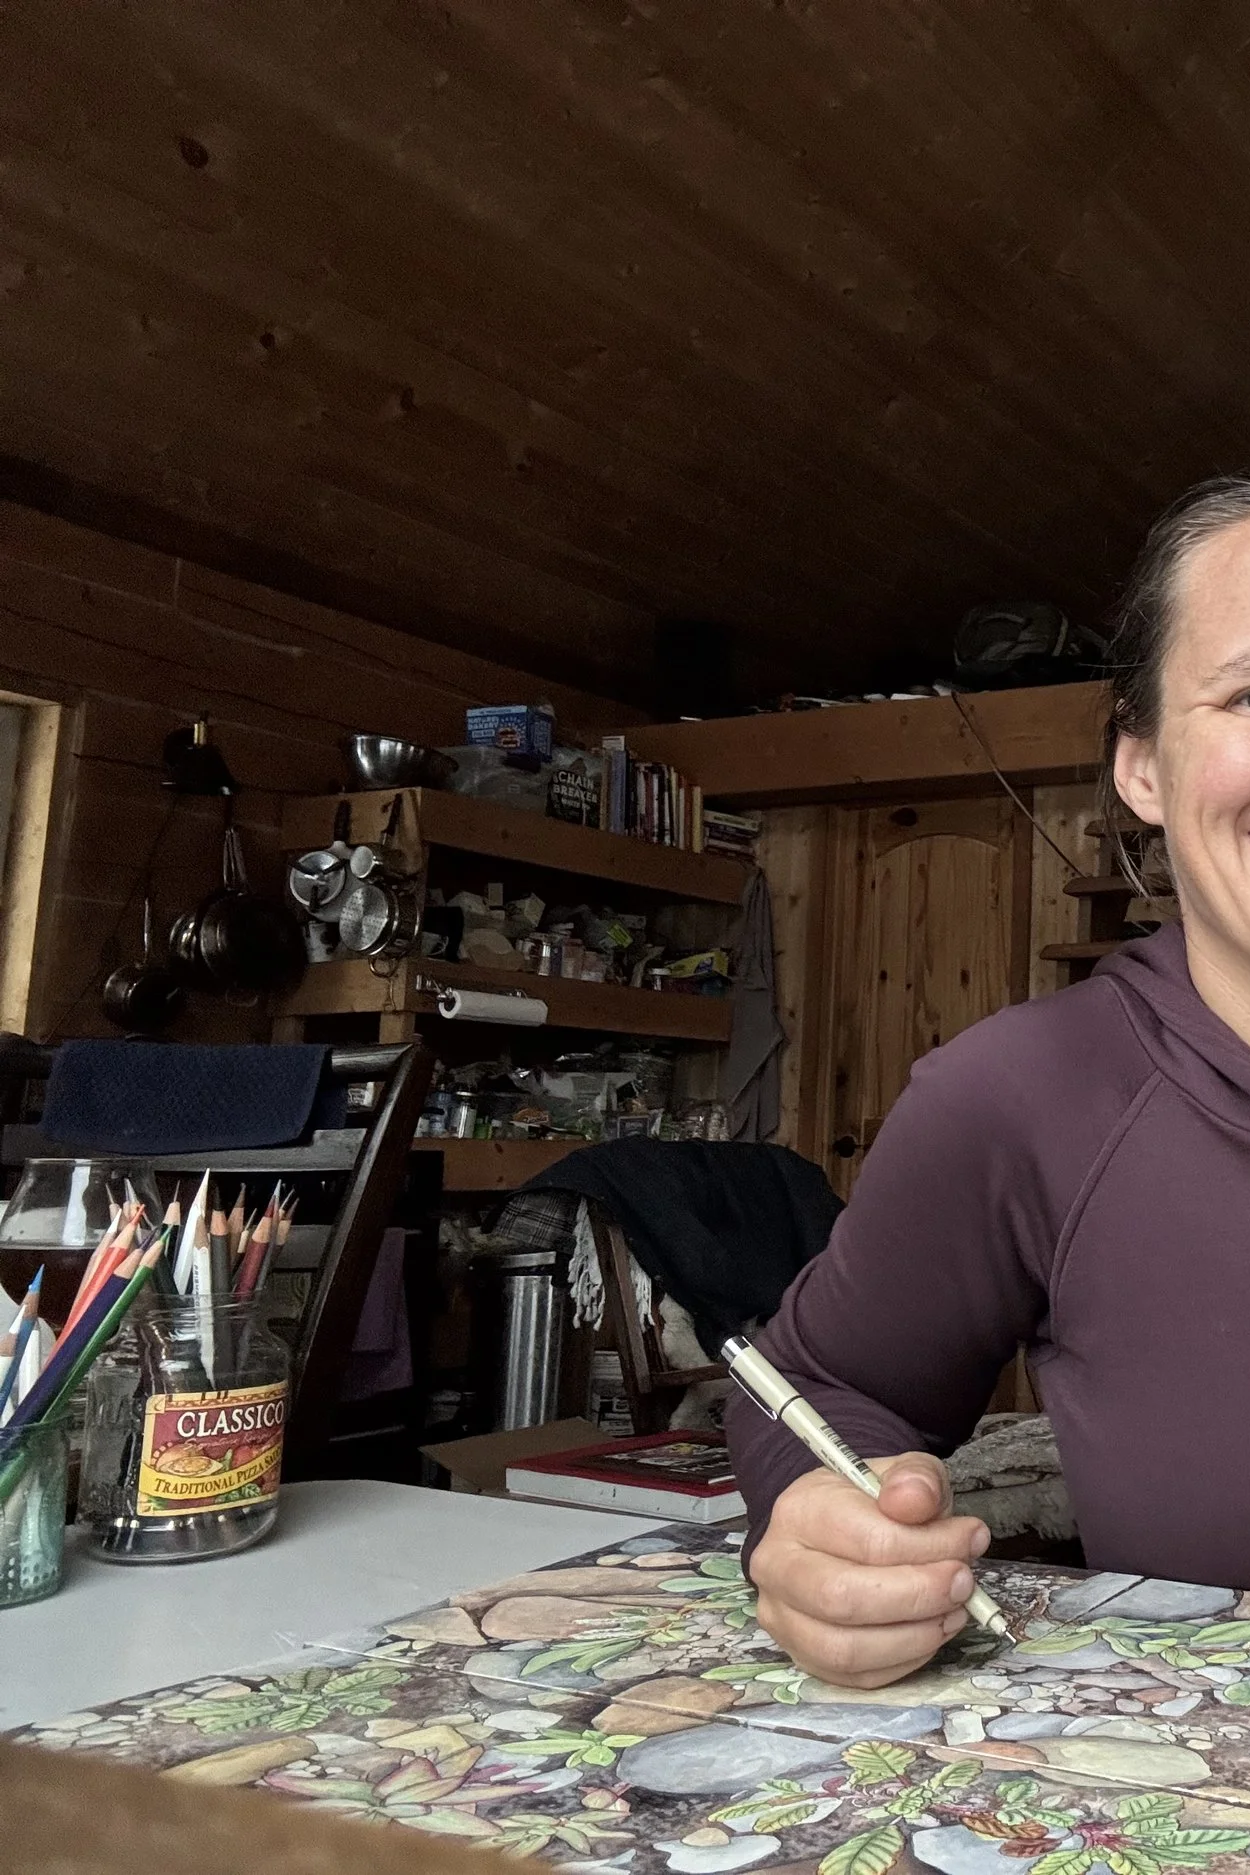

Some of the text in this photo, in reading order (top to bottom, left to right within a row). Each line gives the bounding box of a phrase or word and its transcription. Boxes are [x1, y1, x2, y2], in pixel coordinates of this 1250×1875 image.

[559, 771, 594, 791] CHAIN
[177, 1400, 285, 1438] CLASSICO
[154, 1475, 235, 1495] TRADITIONAL
[237, 1464, 264, 1484] PIZZA
